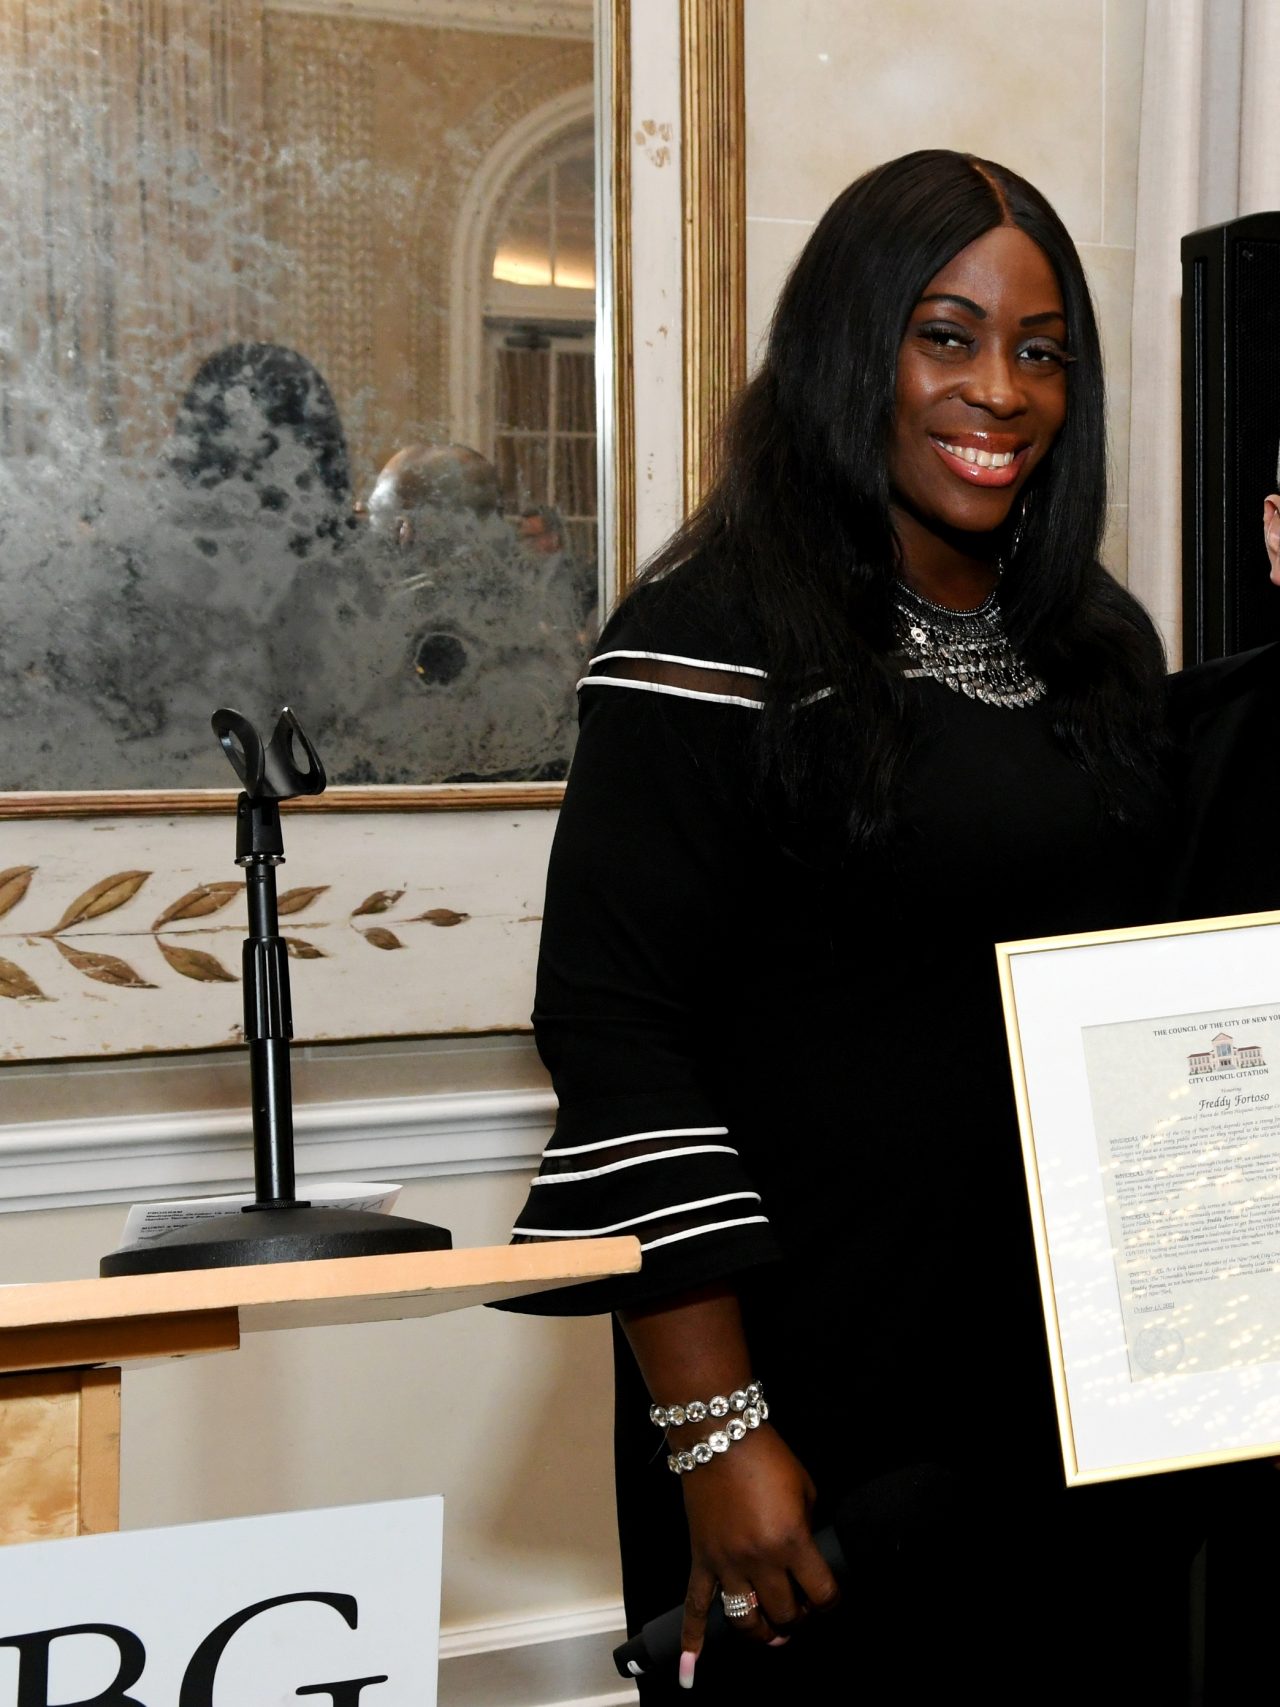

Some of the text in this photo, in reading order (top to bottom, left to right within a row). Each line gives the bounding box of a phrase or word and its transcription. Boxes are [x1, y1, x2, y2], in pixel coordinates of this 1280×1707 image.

[1168, 1026, 1197, 1035] COUNCIL
[1251, 1016, 1268, 1024] NEW
[1188, 1068, 1269, 1085] CITY COUNCIL CITATION
[1198, 1091, 1270, 1113] Freddy Fortoso
